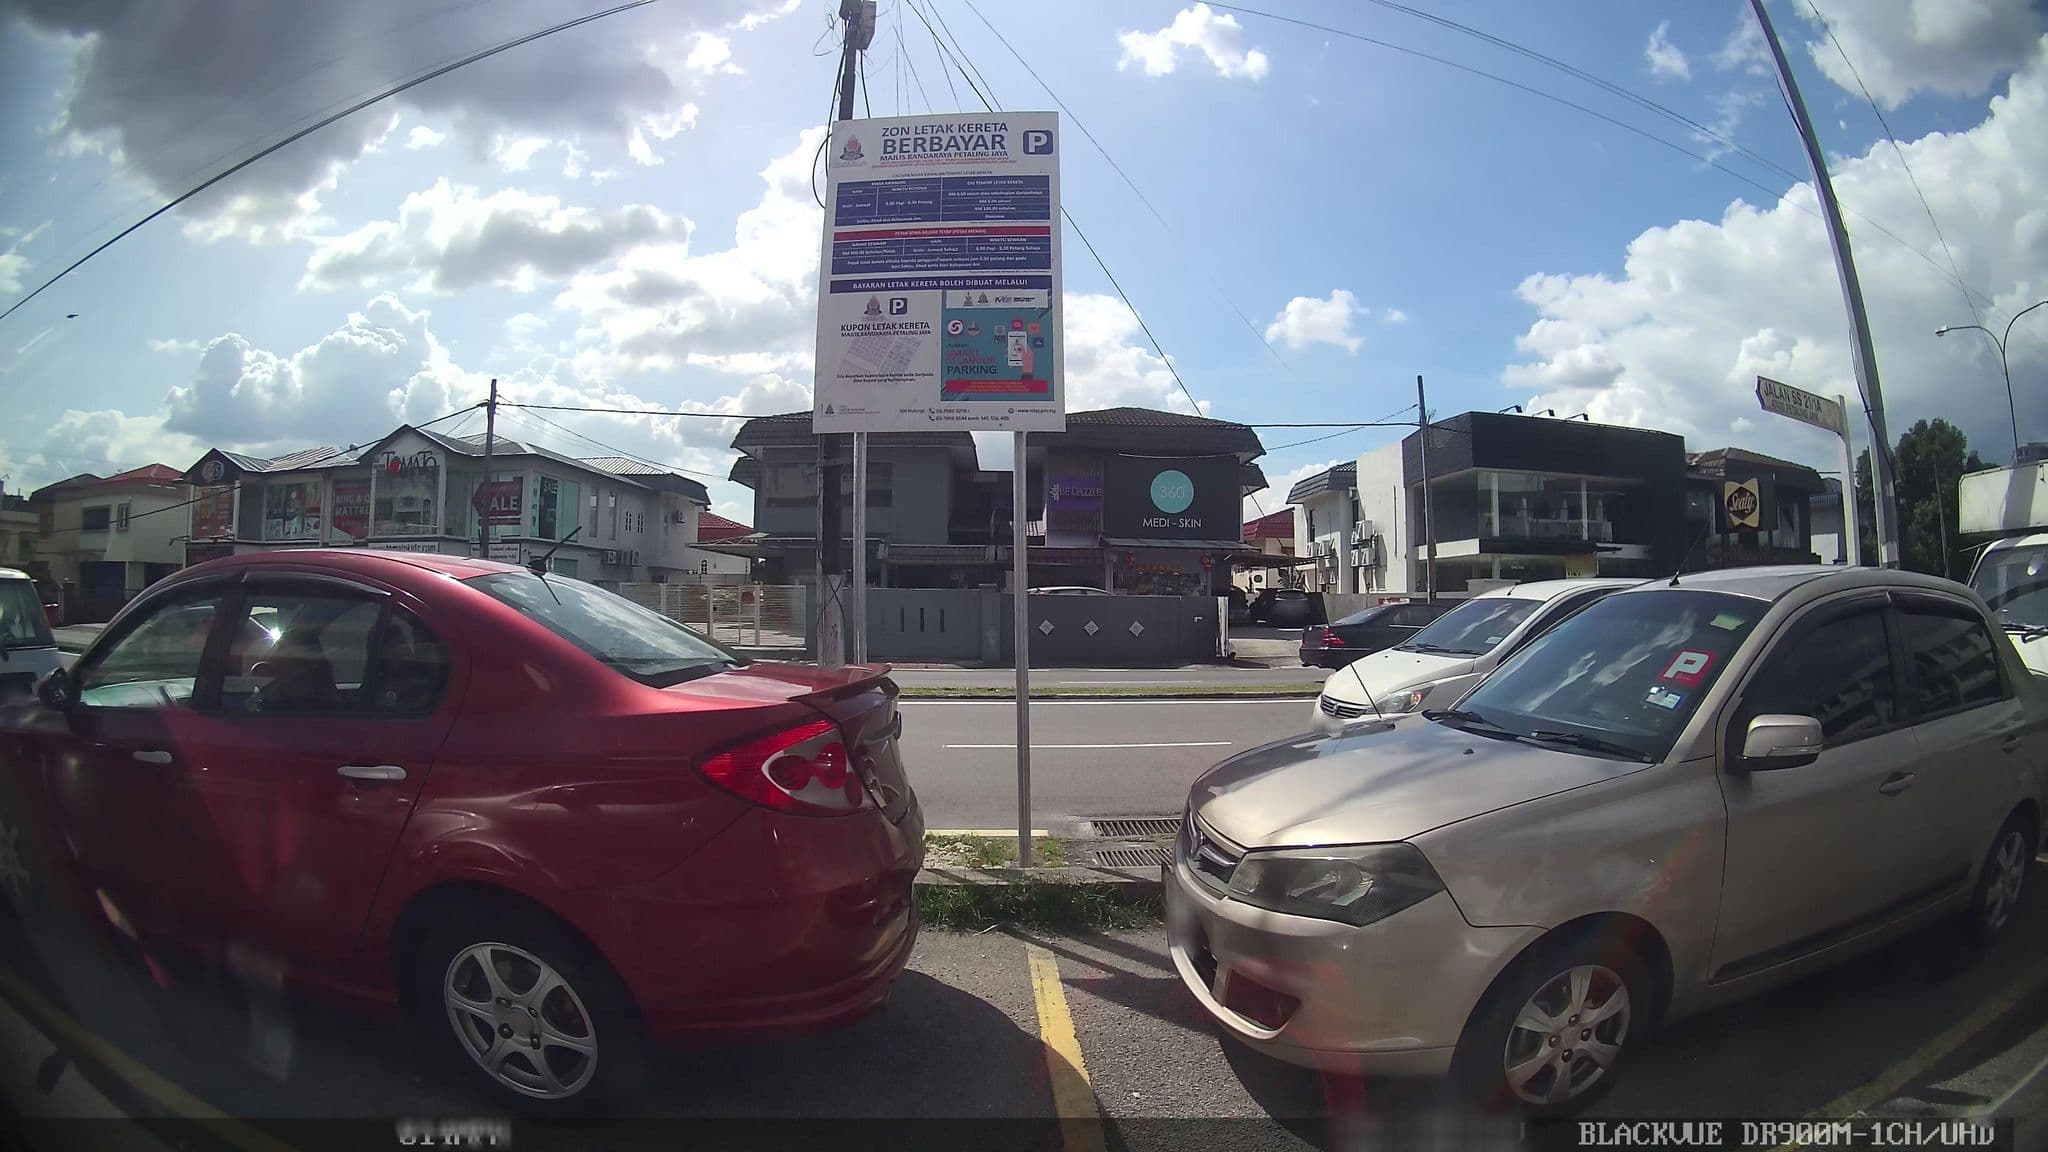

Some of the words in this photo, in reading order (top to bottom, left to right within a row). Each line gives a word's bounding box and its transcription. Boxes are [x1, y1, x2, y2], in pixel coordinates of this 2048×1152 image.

[882, 126, 911, 137] ZON
[914, 124, 953, 136] LETAK
[958, 122, 1008, 134] KERETA
[882, 134, 1006, 155] BERBAYAR
[1028, 132, 1048, 153] P
[880, 154, 906, 162] MAJLIS
[907, 152, 952, 160] BANDARAYA
[953, 151, 989, 159] PETALING
[991, 150, 1008, 158] JAYA
[840, 323, 871, 332] KUPON
[872, 322, 897, 330] LETAK
[898, 321, 930, 329] KERETA
[947, 366, 998, 375] PARKING
[1763, 382, 1790, 404] JALAN
[1792, 389, 1803, 407] SS
[1159, 486, 1185, 499] 360
[489, 496, 518, 511] ALE
[1729, 491, 1755, 514] Sealy
[336, 506, 370, 515] MATTRE
[1142, 517, 1170, 528] MEDI
[1179, 518, 1202, 528] SKIN
[1664, 652, 1709, 678] P
